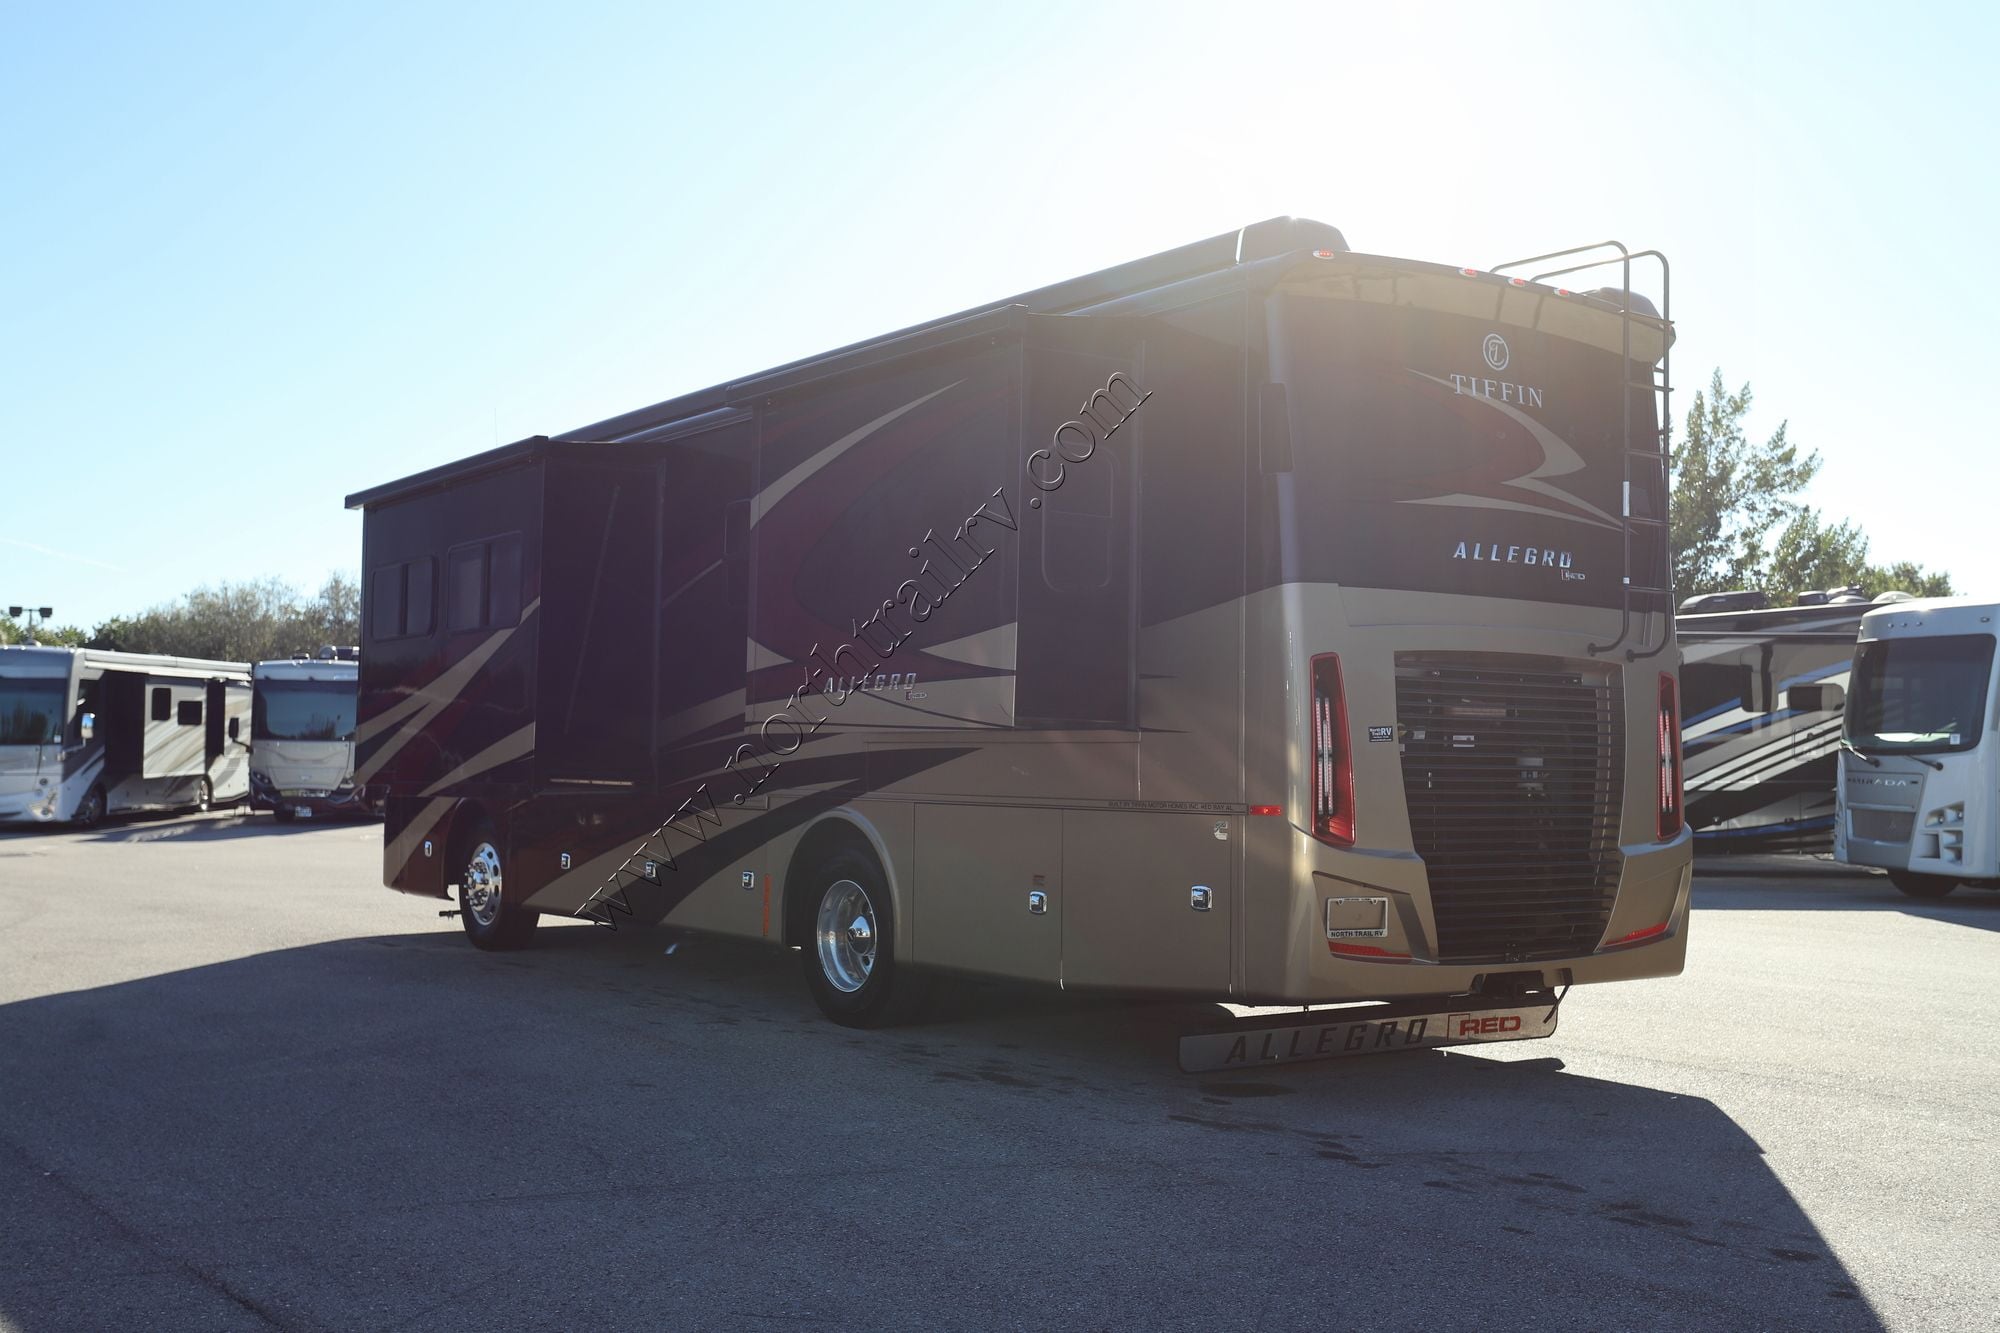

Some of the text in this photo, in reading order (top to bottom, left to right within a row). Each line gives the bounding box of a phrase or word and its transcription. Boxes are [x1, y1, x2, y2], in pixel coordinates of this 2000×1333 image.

[1451, 374, 1542, 408] TIFFIN
[1453, 541, 1572, 568] ALLEGRO
[1380, 727, 1391, 735] RV
[1225, 1015, 1521, 1065] ALLEGRO RED
